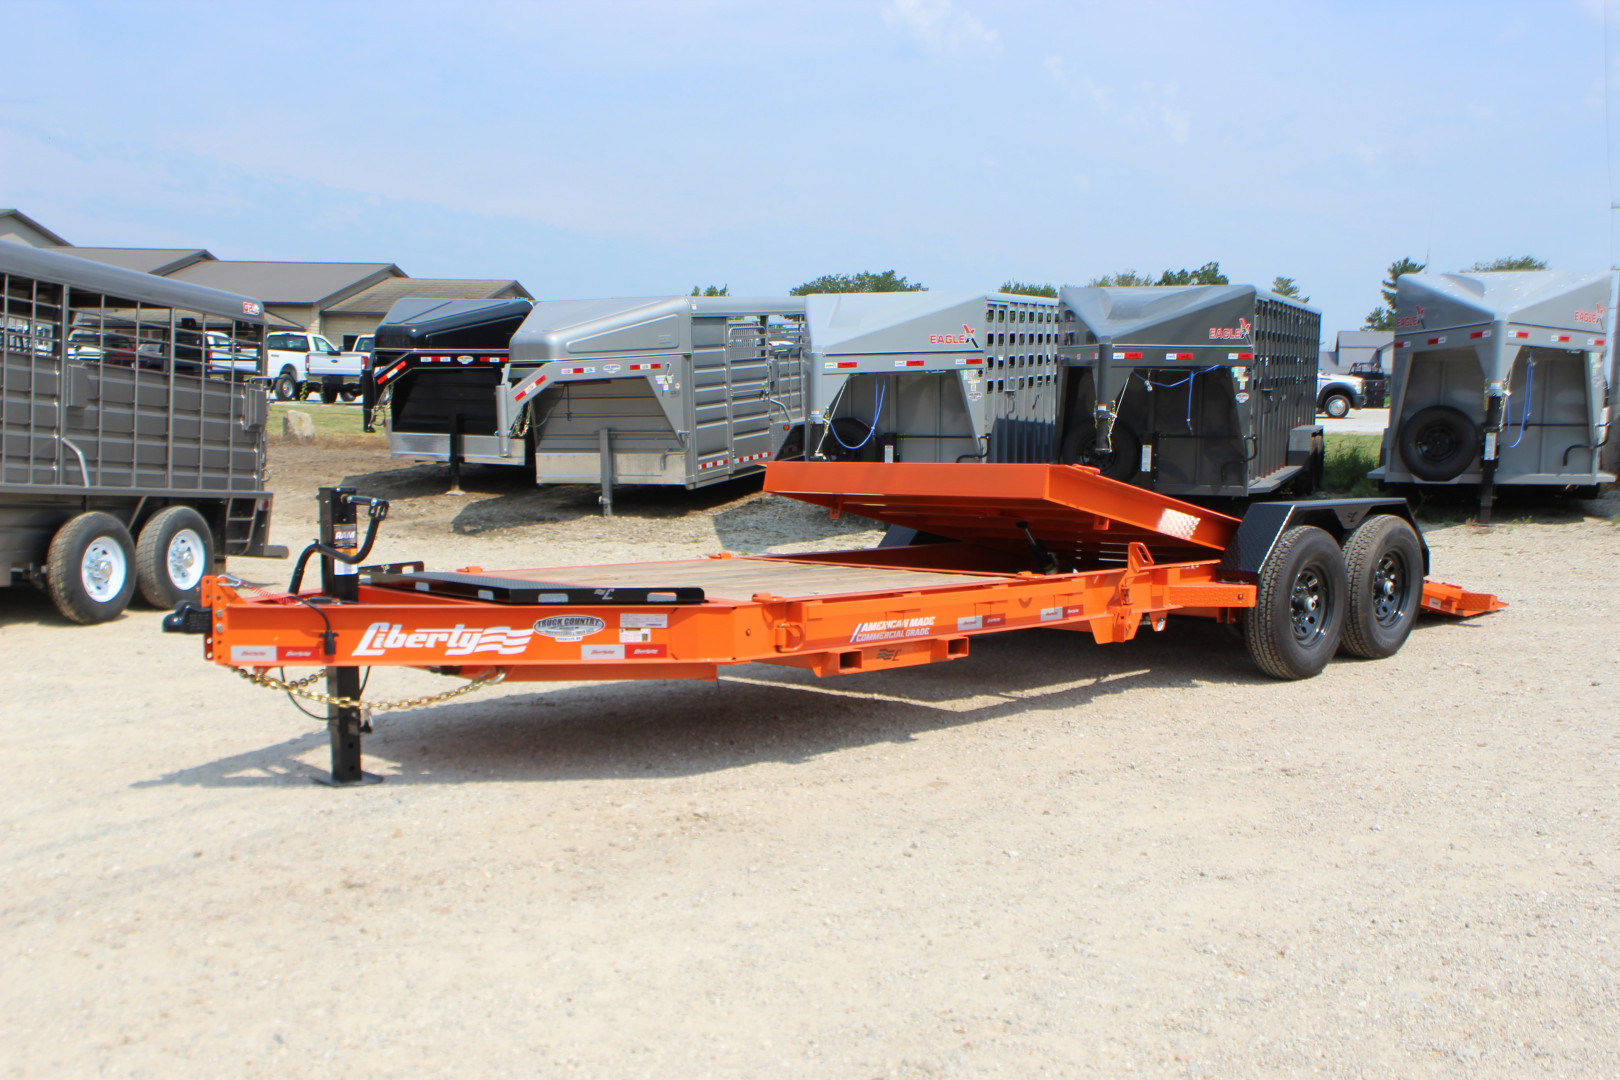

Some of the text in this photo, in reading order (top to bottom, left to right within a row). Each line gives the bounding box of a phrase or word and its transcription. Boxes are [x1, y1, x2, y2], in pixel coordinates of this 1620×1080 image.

[929, 334, 965, 344] EAGLE
[1208, 327, 1242, 340] EAGLE
[334, 531, 356, 540] RAM
[537, 617, 600, 628] TRUCK COUNTRY
[860, 616, 936, 633] AMERICAN MADE
[351, 622, 484, 656] Liberty
[855, 627, 931, 643] COMMERCIAL GRADE
